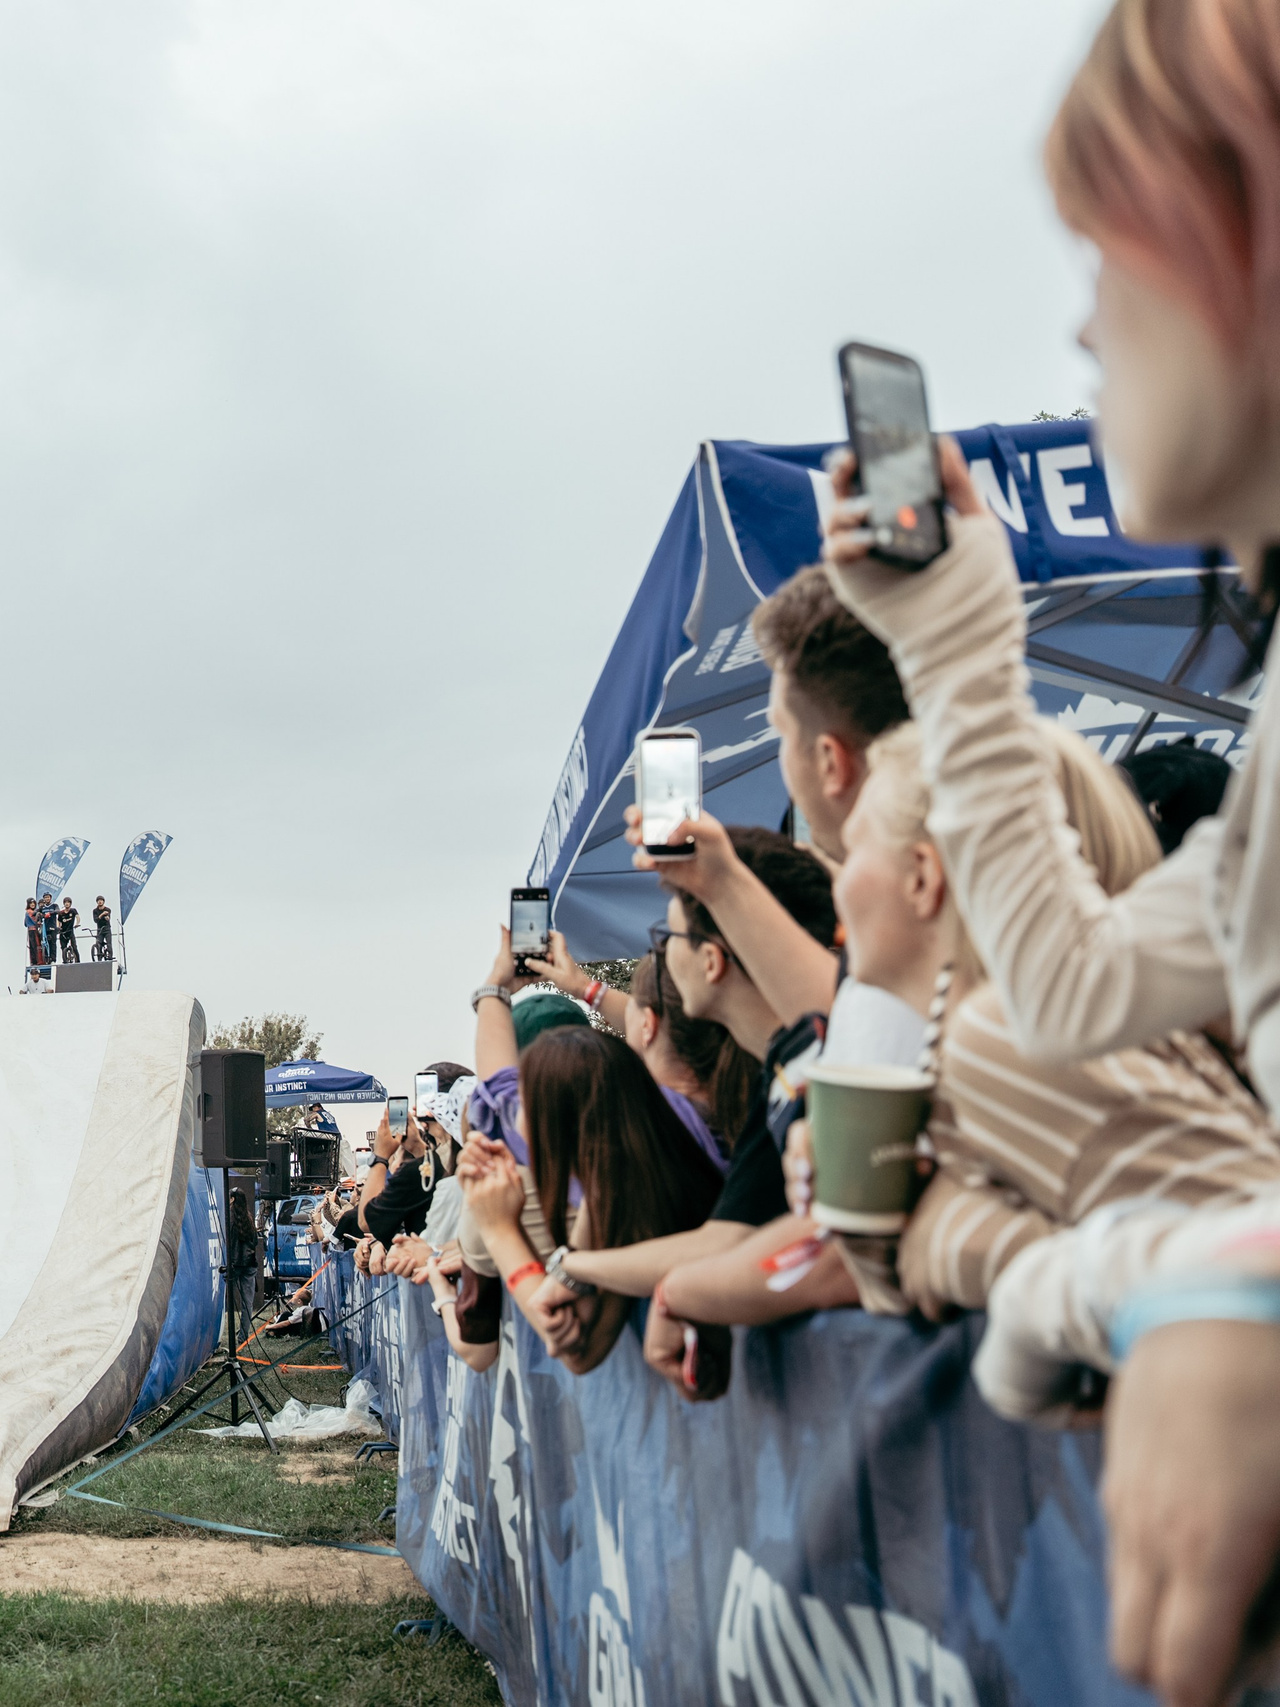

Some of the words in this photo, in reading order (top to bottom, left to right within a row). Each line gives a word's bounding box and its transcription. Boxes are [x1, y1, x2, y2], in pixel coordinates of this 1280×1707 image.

[39, 870, 65, 888] GORILLA
[121, 864, 148, 883] GORILLA
[275, 1081, 307, 1093] INSTINCT
